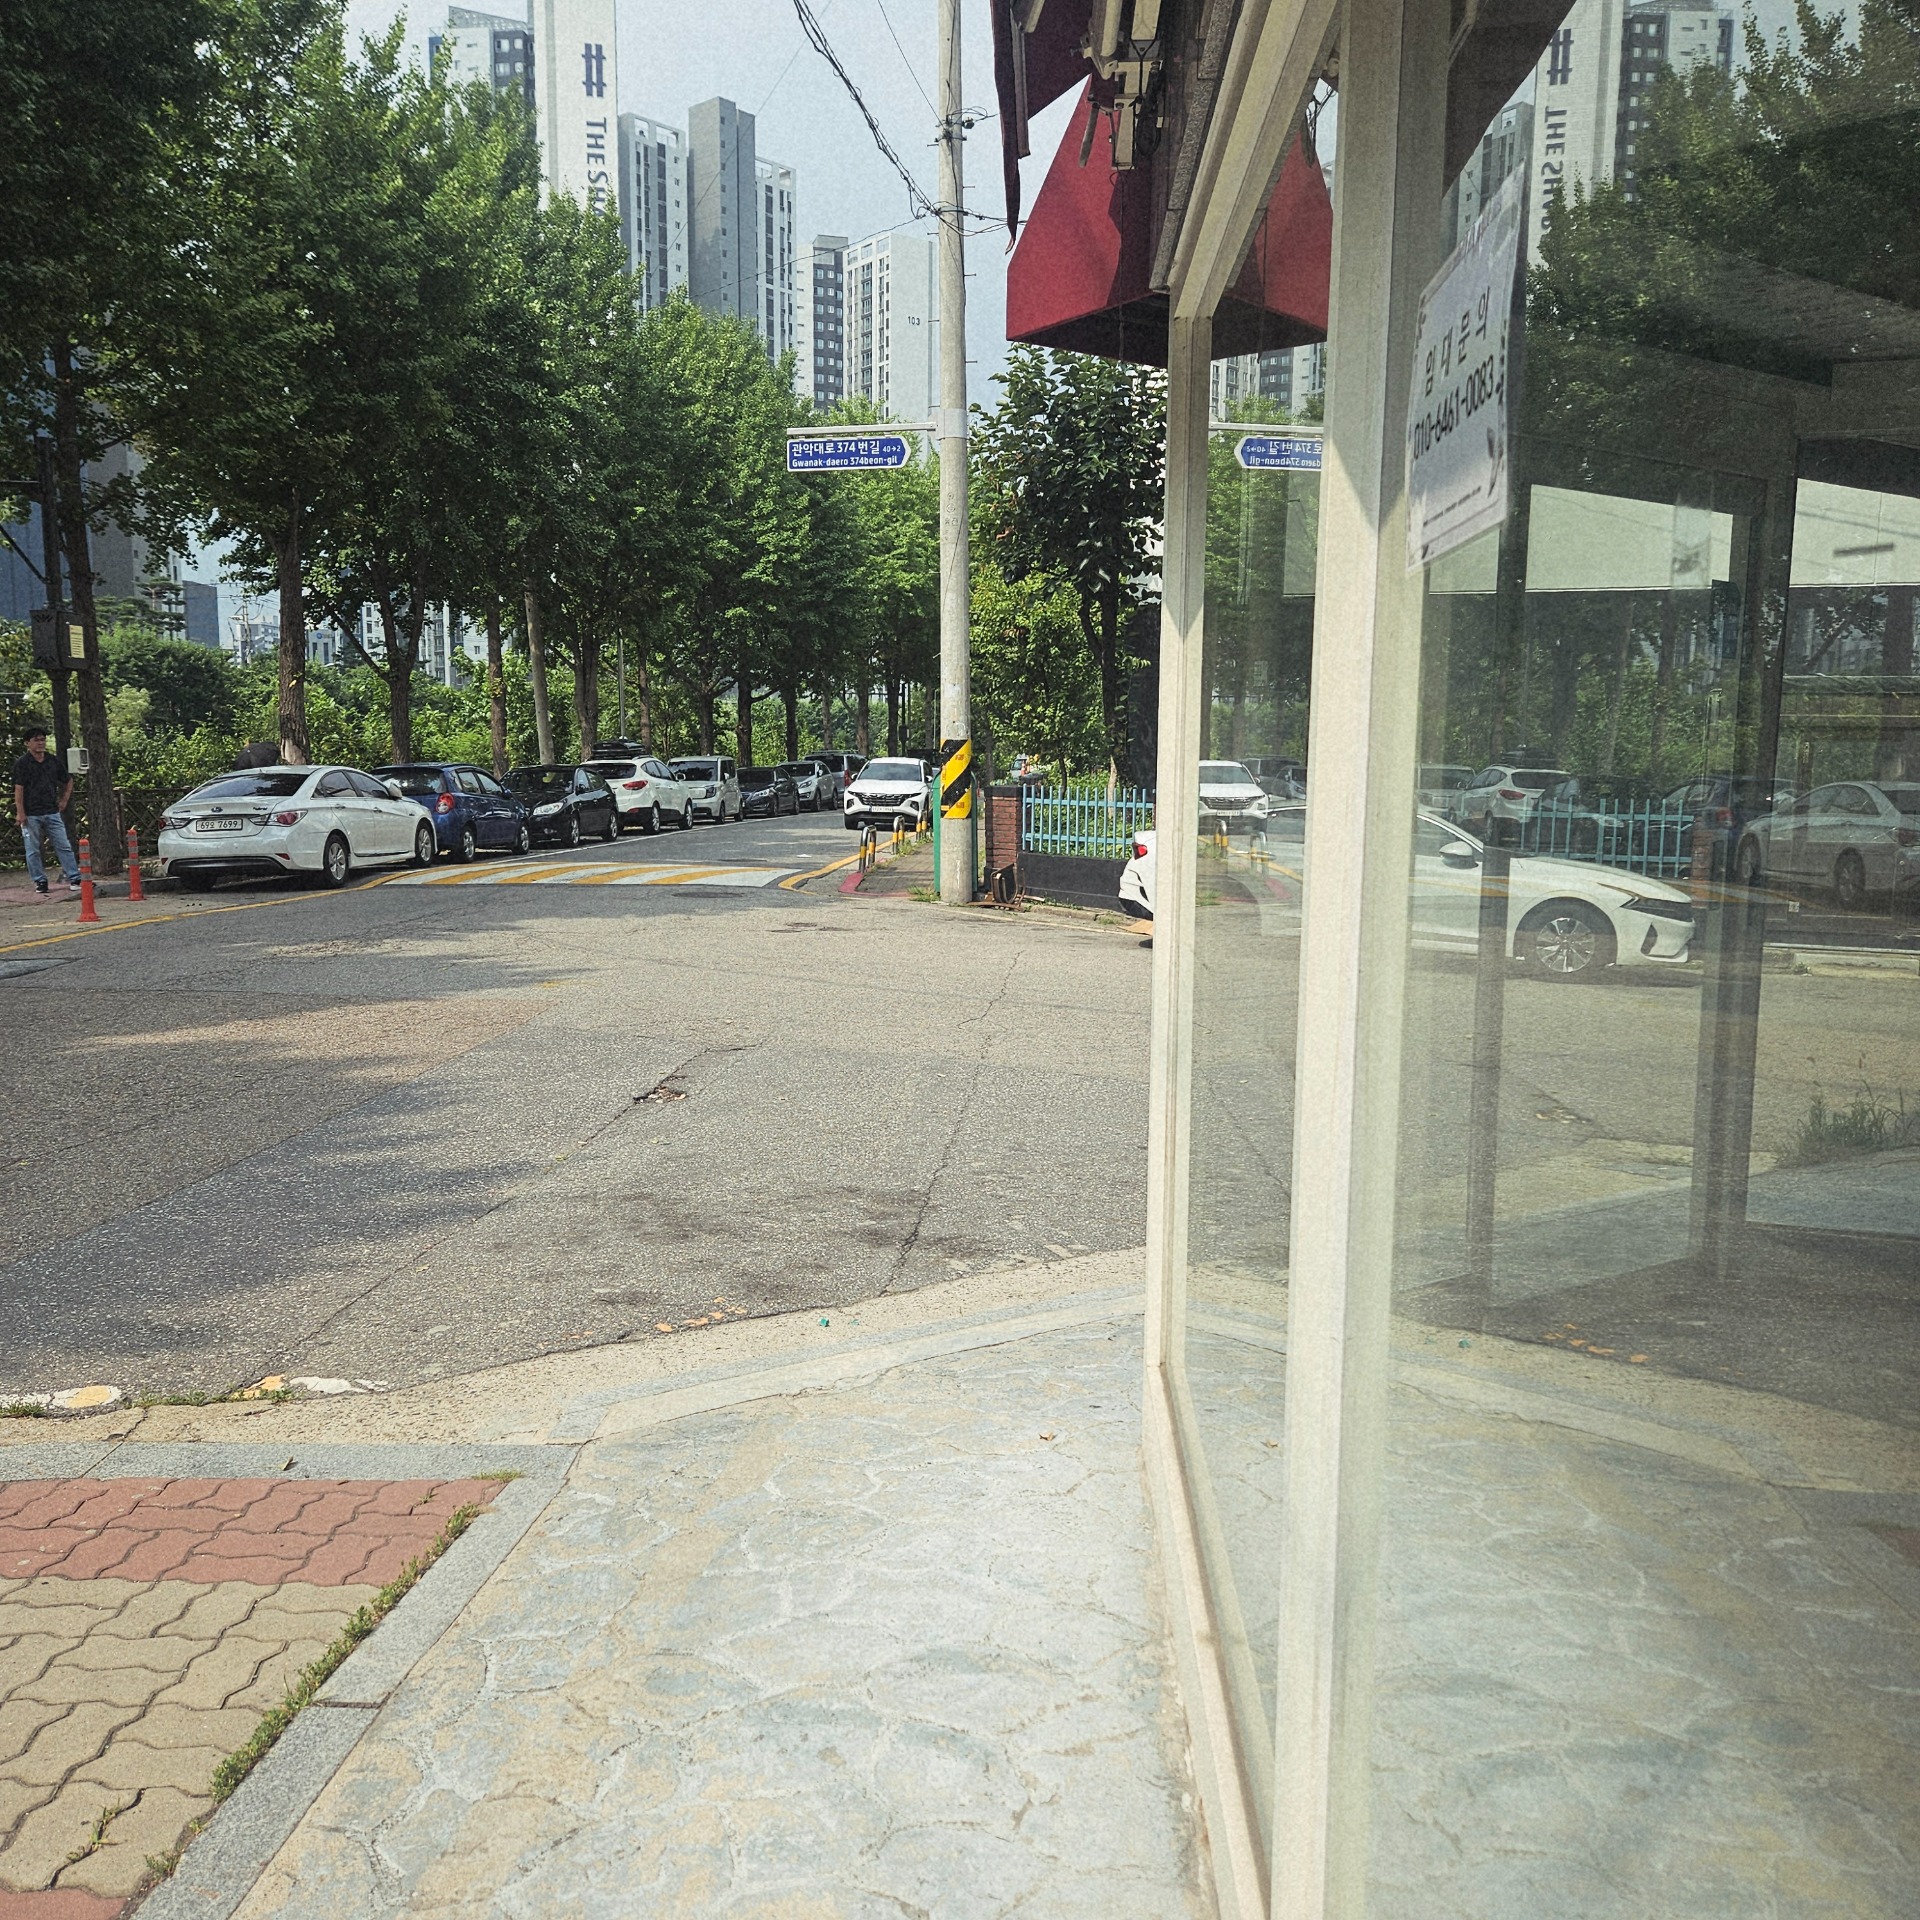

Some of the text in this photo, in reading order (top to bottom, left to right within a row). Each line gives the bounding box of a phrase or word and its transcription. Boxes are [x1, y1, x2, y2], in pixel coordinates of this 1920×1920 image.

[907, 315, 921, 326] 103
[1413, 354, 1493, 460] 010-6461-0083
[792, 455, 898, 468] Gwanak-daero 374beon-gil
[217, 820, 238, 829] 7699
